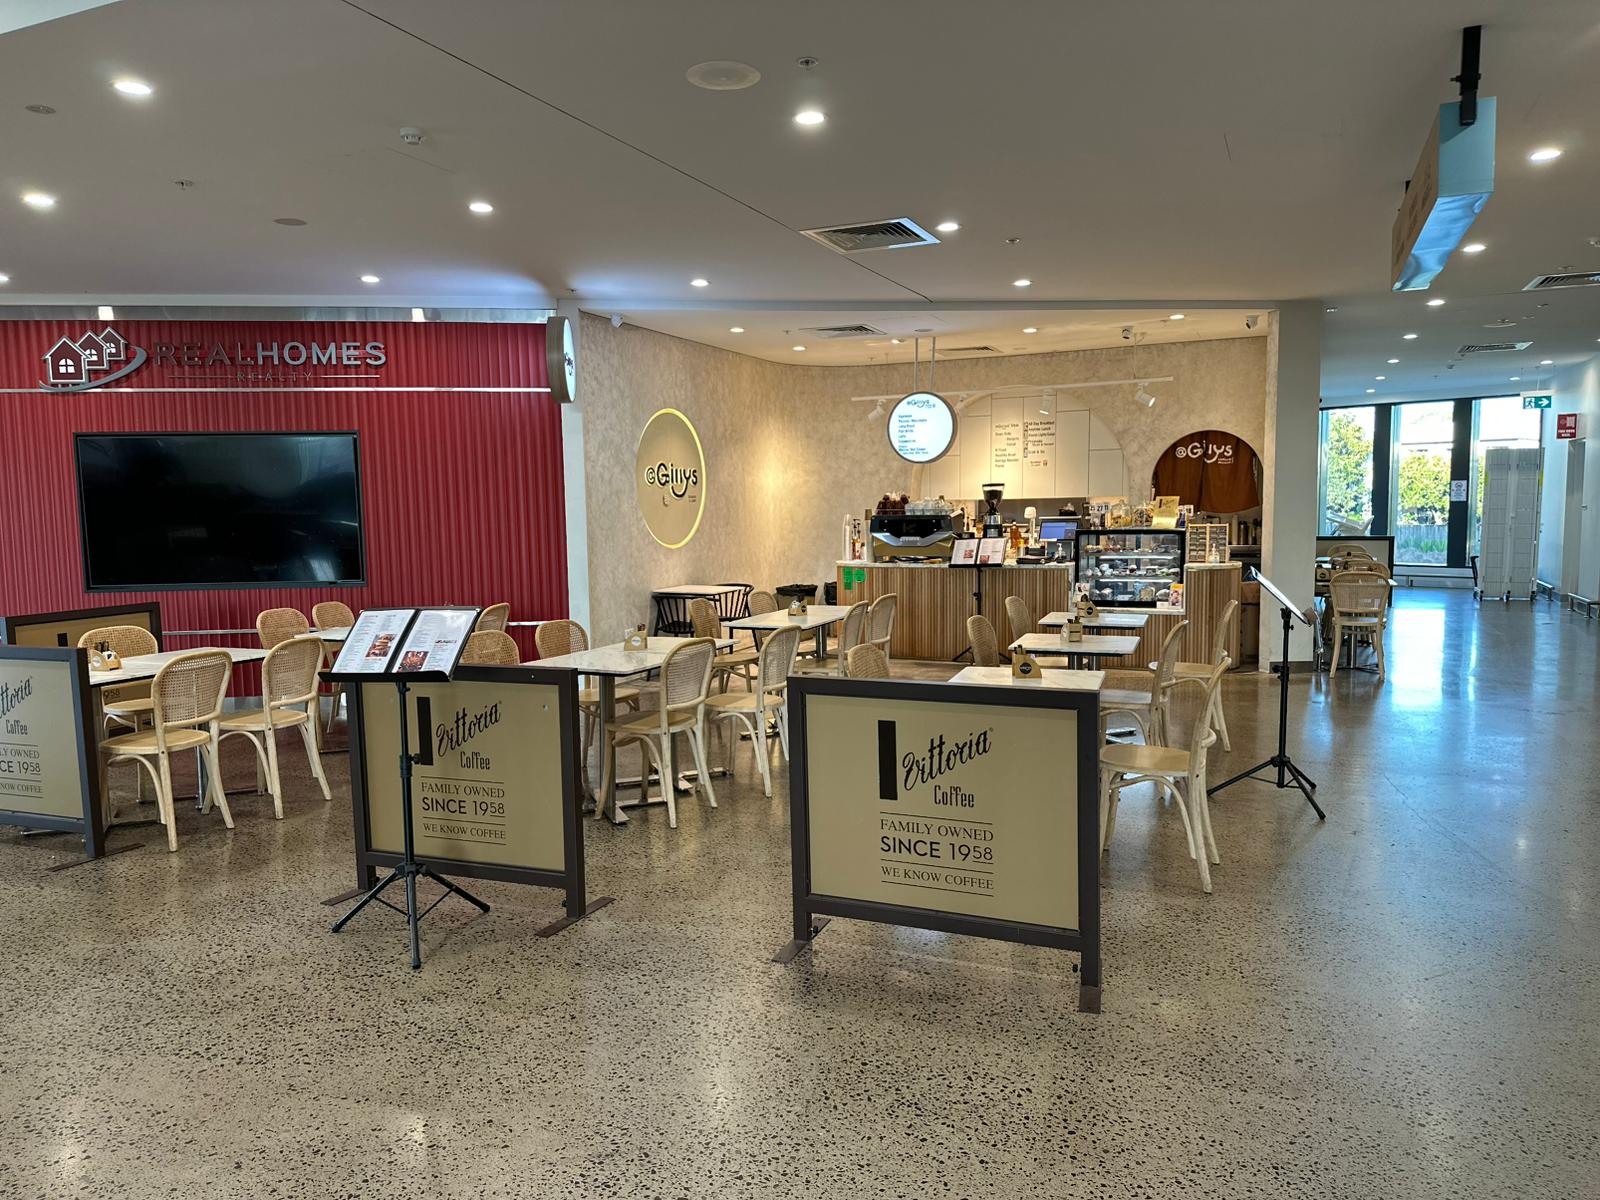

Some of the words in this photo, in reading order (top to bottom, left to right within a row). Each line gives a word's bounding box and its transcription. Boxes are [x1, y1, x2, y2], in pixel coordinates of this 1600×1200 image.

[154, 342, 387, 366] REALHOMES
[237, 371, 313, 382] REALTY
[0, 677, 33, 719] ttoria
[103, 688, 121, 699] 958
[436, 702, 501, 757] Vittoria
[10, 749, 40, 759] OWNED
[460, 751, 490, 770] Coffee
[902, 729, 992, 791] Vittoria
[17, 760, 41, 774] 1958
[17, 784, 43, 793] COFFEE
[421, 781, 461, 795] FAMILY
[463, 785, 505, 799] OWNED
[934, 784, 975, 808] Coffee
[422, 796, 467, 815] SINCE
[472, 800, 505, 816] 1958
[423, 822, 438, 832] WE
[440, 824, 468, 836] KNOW
[469, 827, 507, 840] COFFEE
[880, 818, 934, 836] FAMILY
[937, 825, 994, 842] OWNED
[880, 835, 941, 859] SINCE
[949, 842, 994, 862] 1958
[881, 865, 901, 878] WE
[903, 868, 943, 883] KNOW
[944, 874, 994, 890] COFFEE
